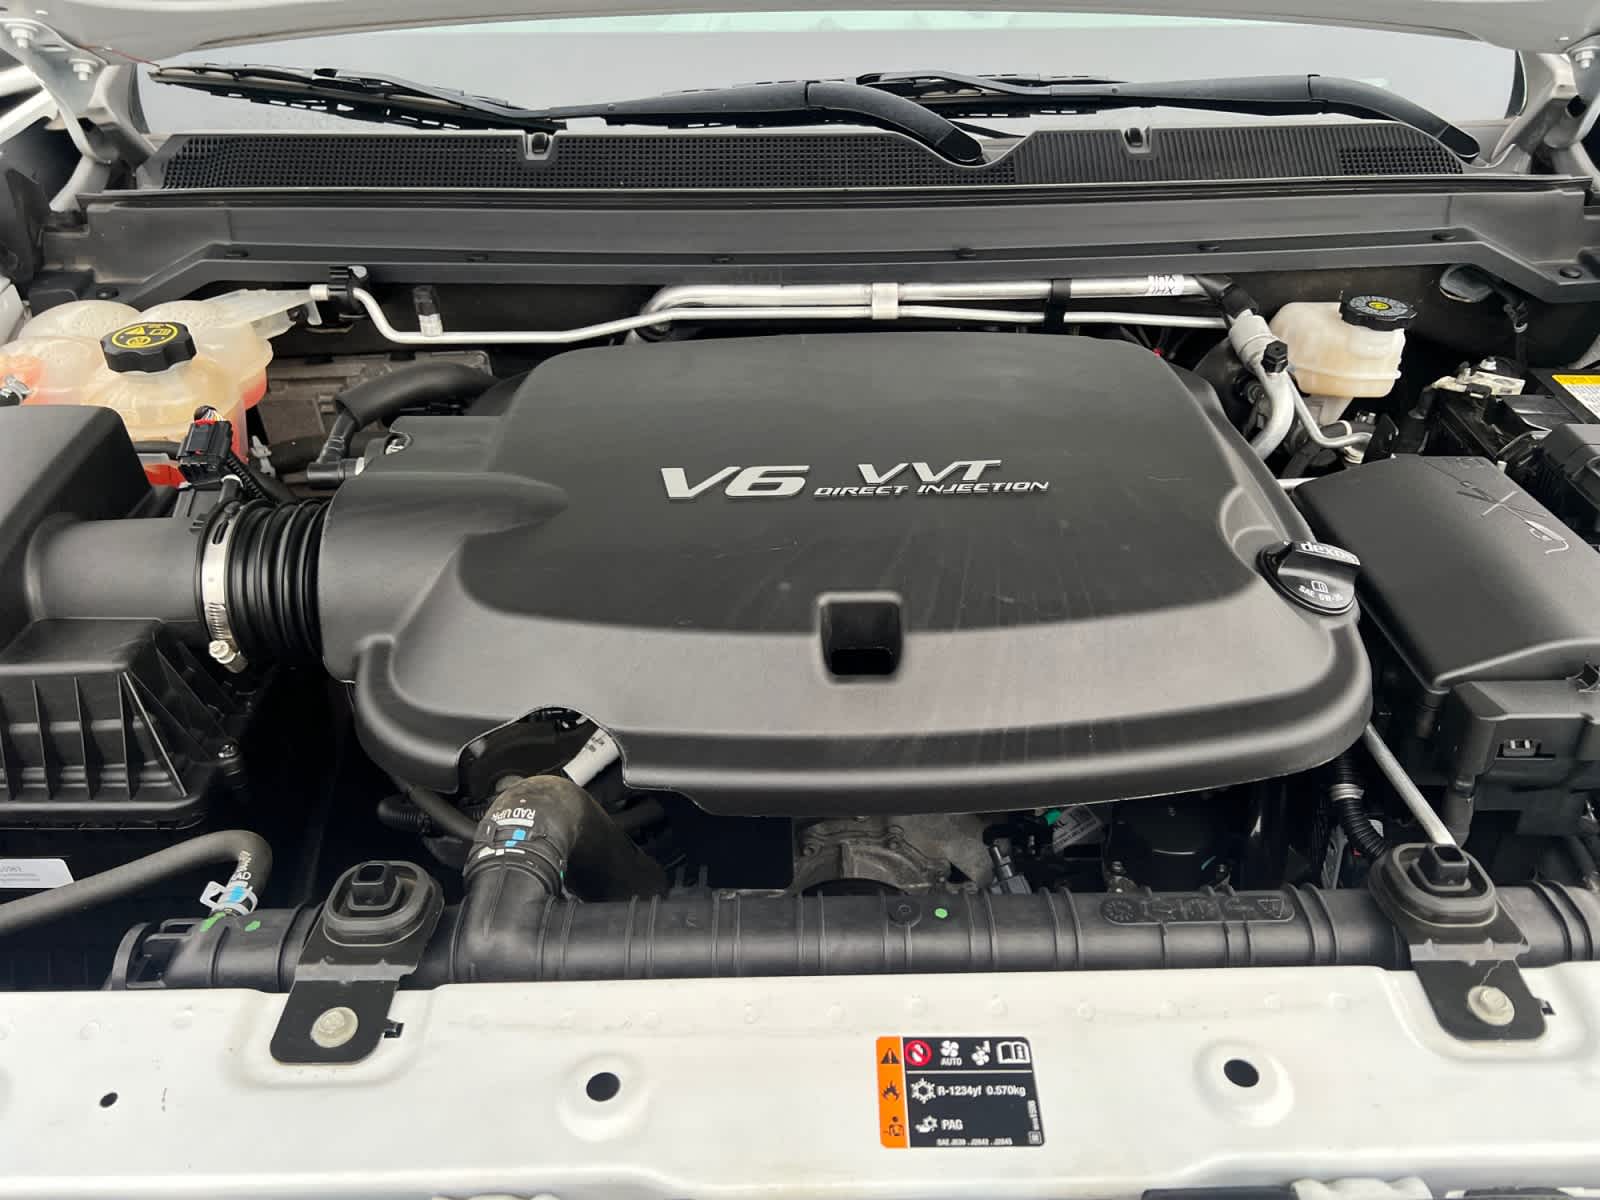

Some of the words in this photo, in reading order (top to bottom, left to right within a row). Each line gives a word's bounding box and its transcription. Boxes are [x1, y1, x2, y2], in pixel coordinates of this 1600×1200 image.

[858, 459, 1003, 484] VVT
[661, 465, 810, 499] V6
[814, 484, 909, 496] DIRECT
[916, 480, 1050, 495] INJECTION
[513, 807, 536, 819] RAD
[940, 1057, 962, 1066] AUTO
[937, 1085, 982, 1098] R-1234yf
[986, 1085, 1026, 1097] 0.570kg
[941, 1119, 963, 1130] PAG
